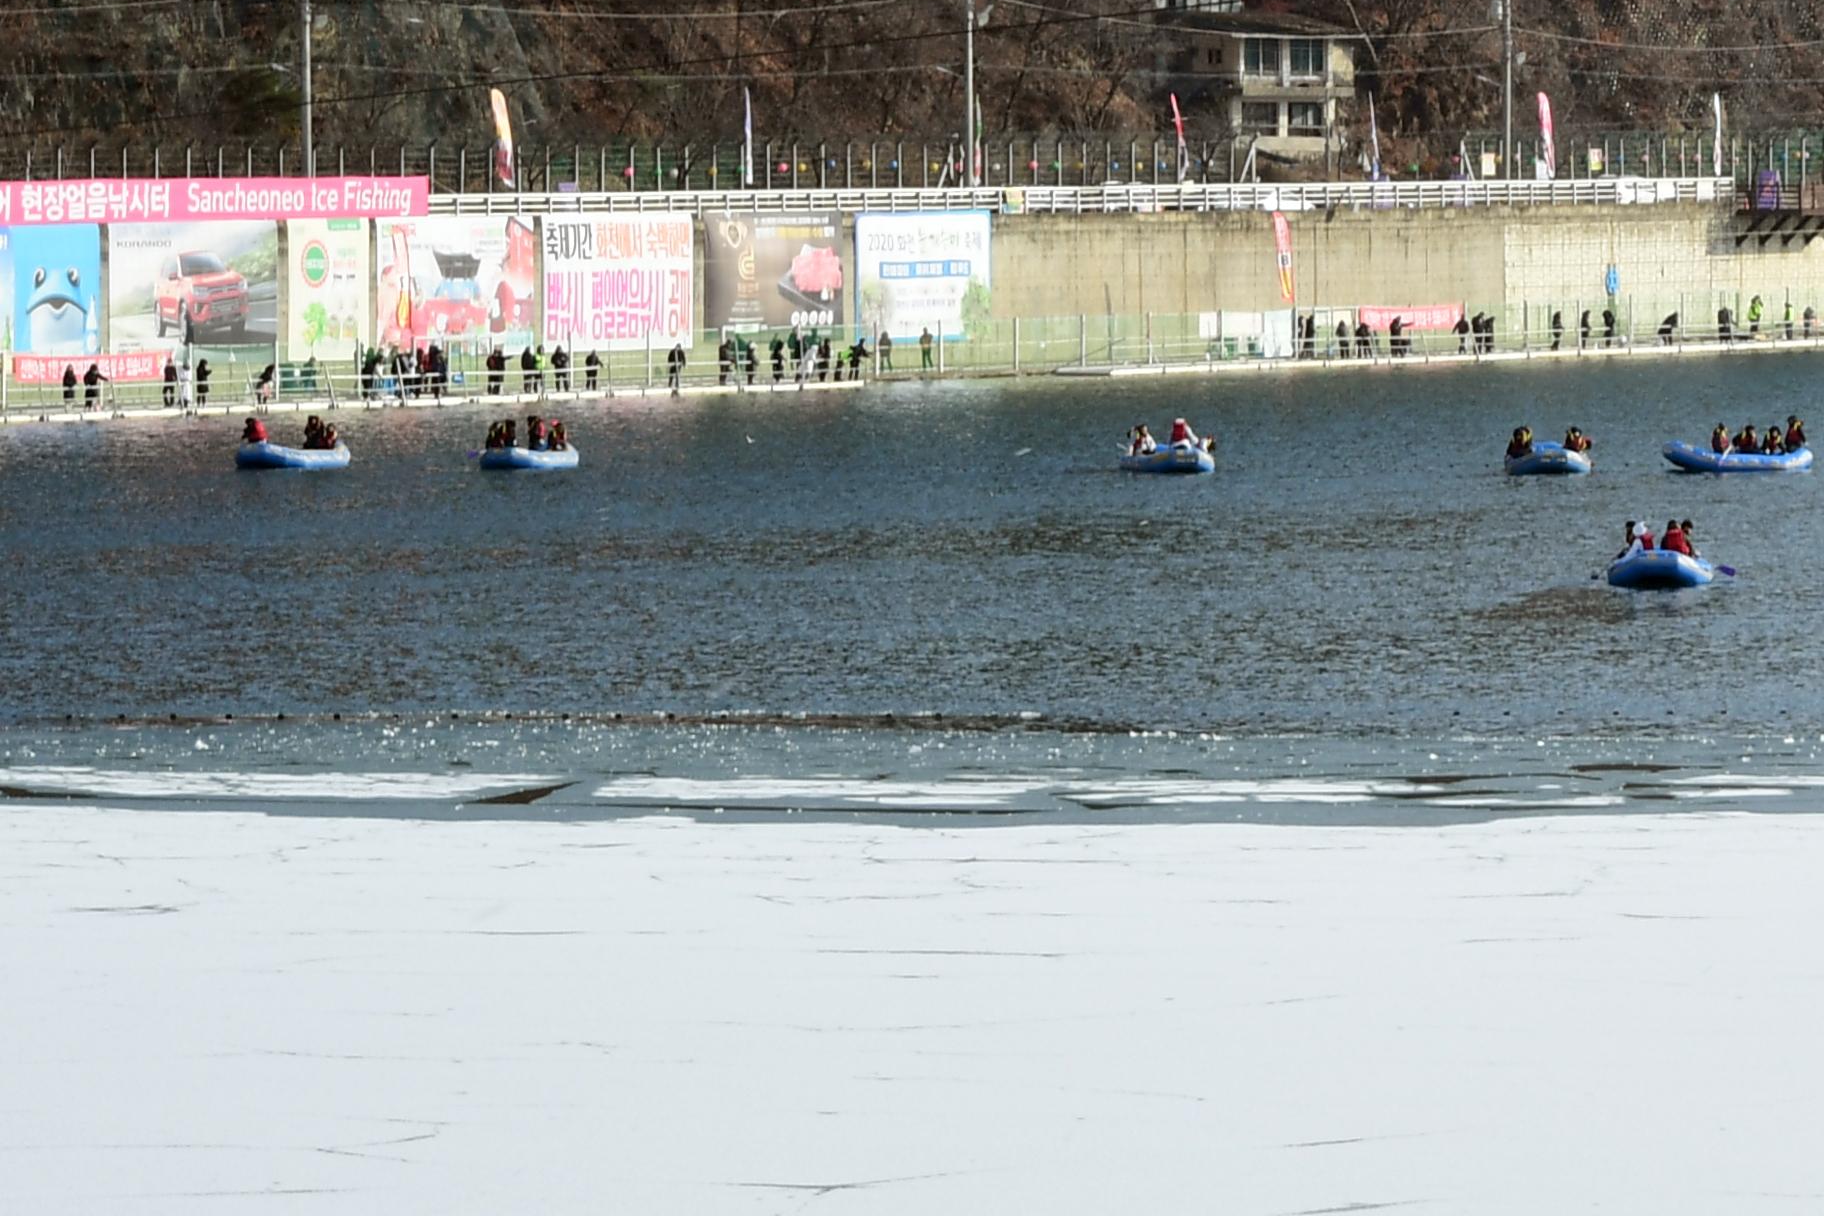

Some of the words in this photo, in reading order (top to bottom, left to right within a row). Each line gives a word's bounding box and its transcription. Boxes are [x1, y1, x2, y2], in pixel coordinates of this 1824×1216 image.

[21, 182, 170, 221] 현장얼음낚시터
[187, 183, 304, 213] Sancheoneo
[311, 182, 338, 211] Ice
[343, 181, 412, 216] Fishing
[546, 222, 592, 261] 축제기간
[596, 222, 643, 259] 화천에서
[647, 221, 690, 259] 숙박하면
[868, 233, 894, 252] 2020
[592, 268, 665, 340] 평일얼음낚시
[669, 269, 690, 338] 공짜
